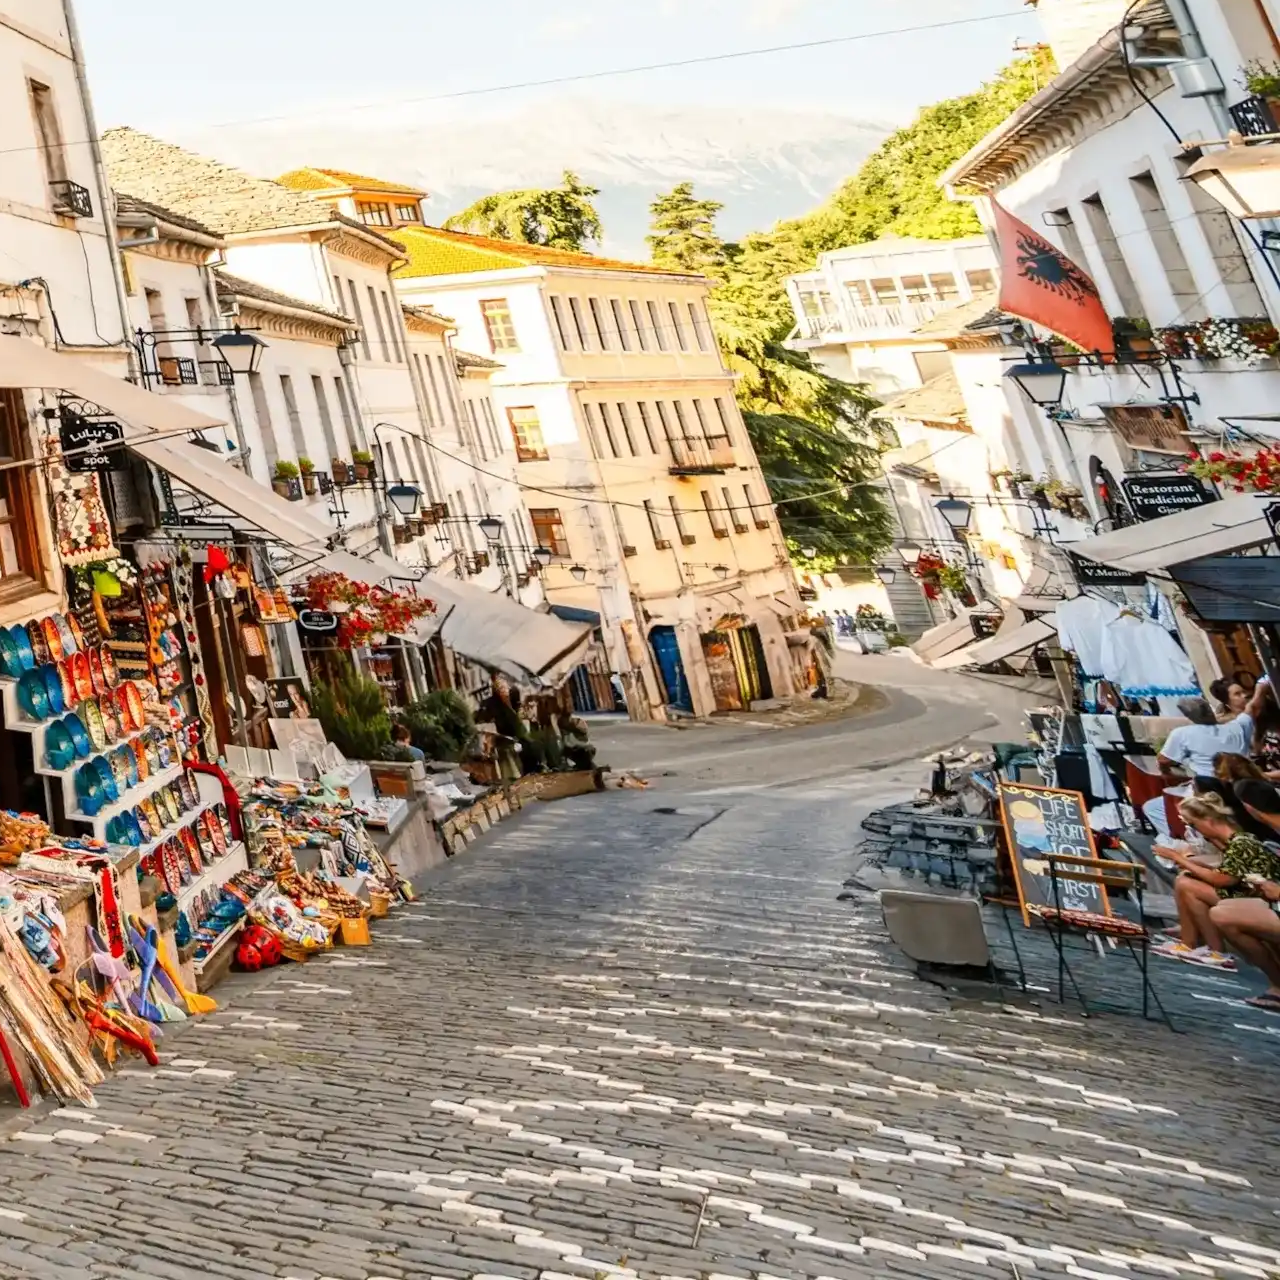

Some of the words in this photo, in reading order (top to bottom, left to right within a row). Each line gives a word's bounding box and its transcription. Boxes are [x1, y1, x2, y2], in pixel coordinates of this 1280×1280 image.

[69, 428, 114, 442] LuLu's
[83, 455, 111, 466] spot
[1131, 484, 1195, 495] Restorant
[1132, 493, 1203, 506] Tradicional
[1039, 799, 1078, 819] LIFE
[1044, 820, 1086, 841] SHORT
